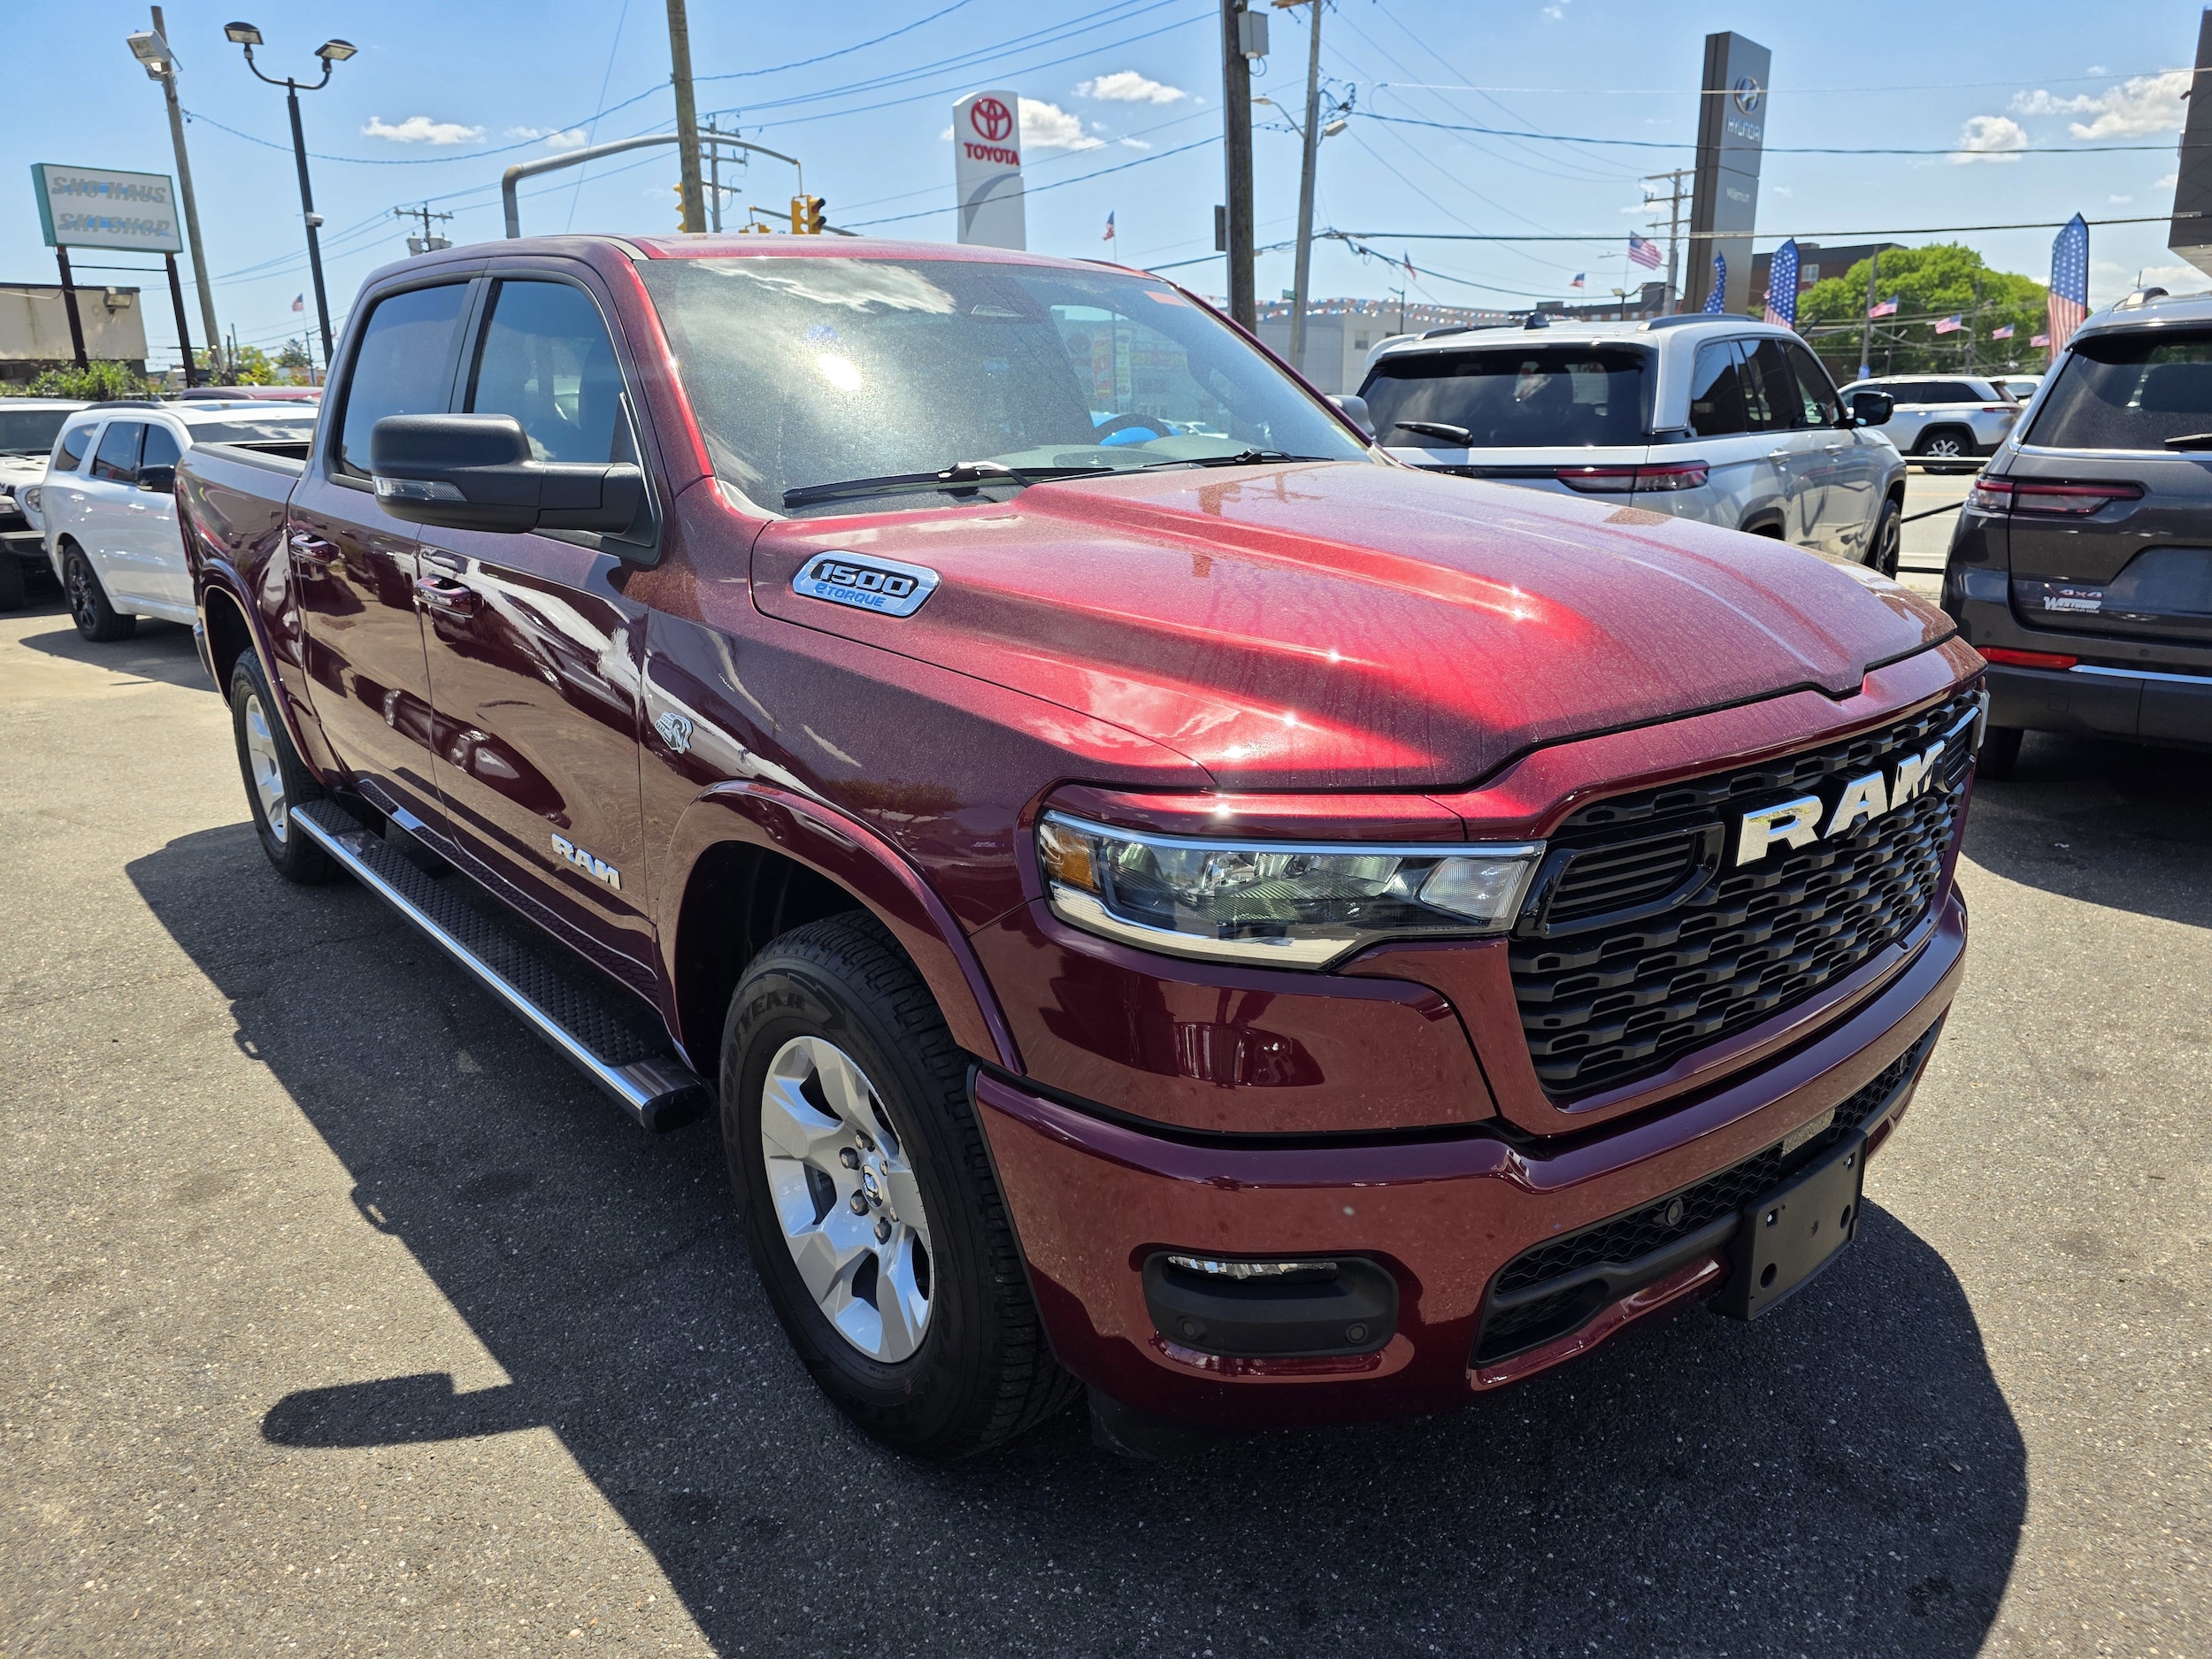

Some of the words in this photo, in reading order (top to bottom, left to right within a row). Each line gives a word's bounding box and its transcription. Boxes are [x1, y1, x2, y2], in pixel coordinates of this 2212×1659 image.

[1726, 116, 1762, 142] HYUNDAI
[964, 142, 1020, 166] TOYOTA
[50, 176, 99, 198] SNO
[105, 181, 166, 204] HAUS
[57, 212, 102, 233] SKI
[106, 216, 171, 237] SHOP
[818, 563, 914, 597] 1500
[1736, 740, 1946, 867] RAM
[551, 833, 622, 891] RAM
